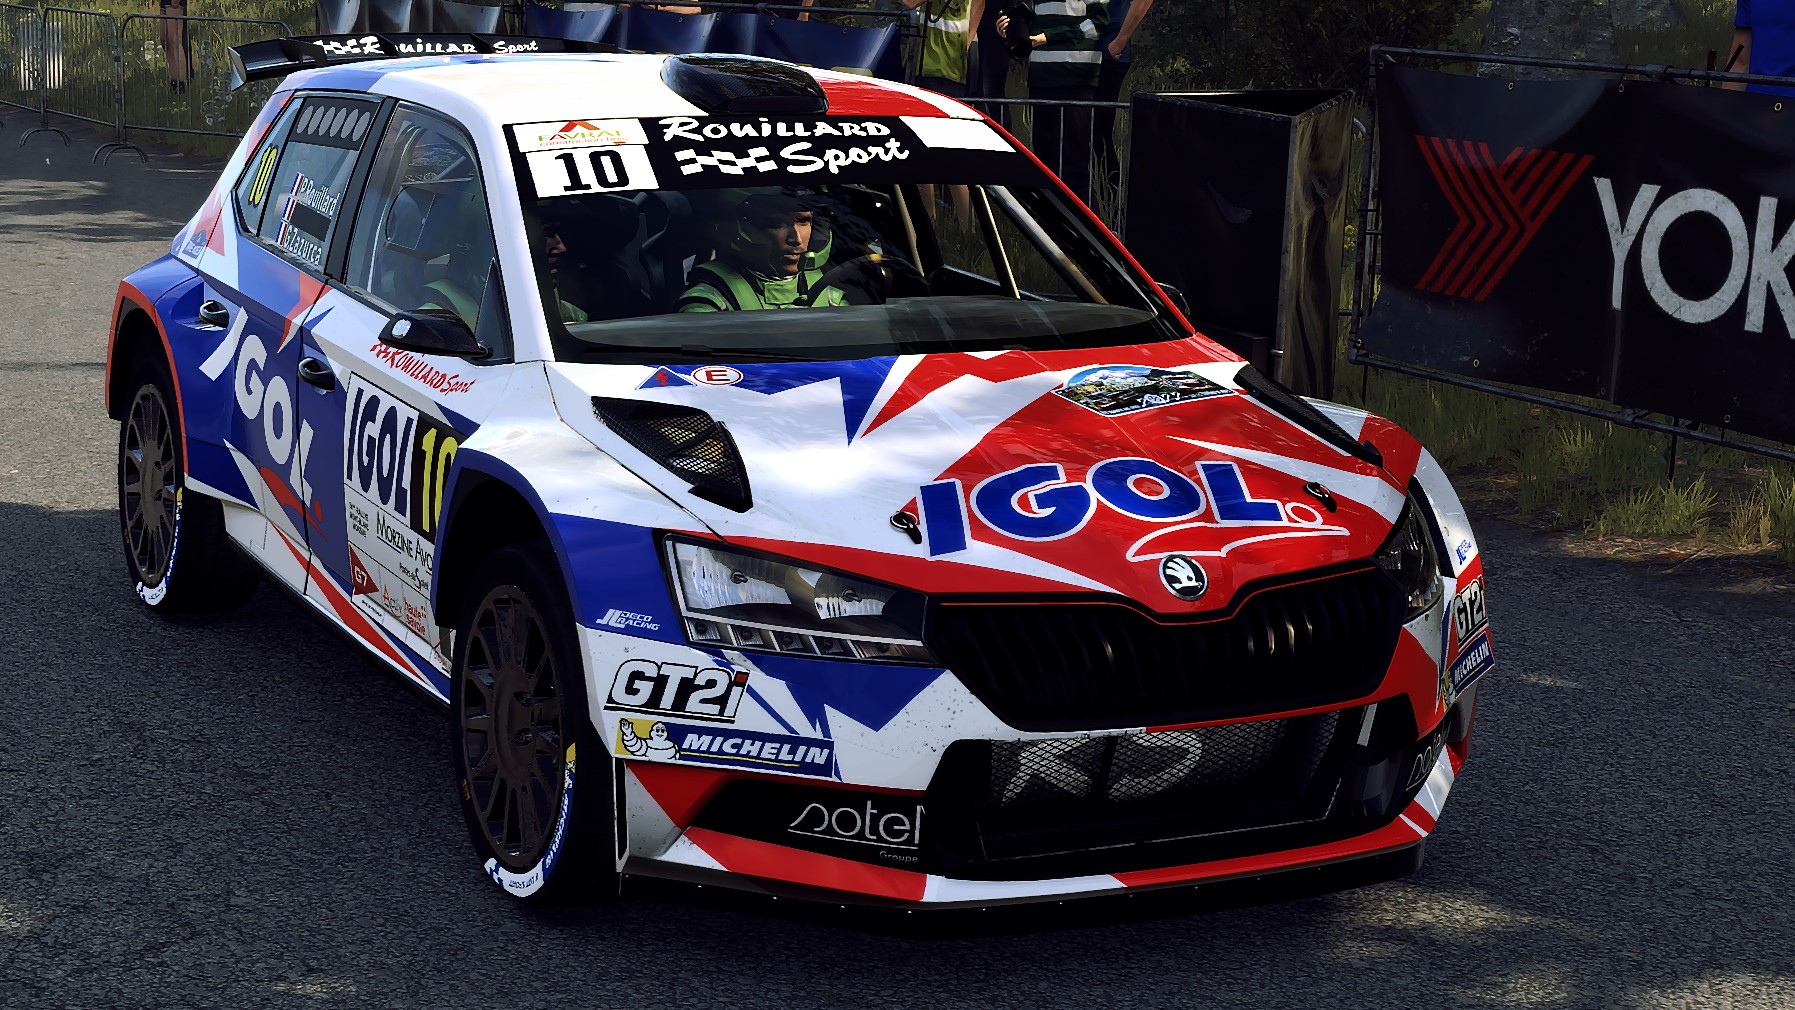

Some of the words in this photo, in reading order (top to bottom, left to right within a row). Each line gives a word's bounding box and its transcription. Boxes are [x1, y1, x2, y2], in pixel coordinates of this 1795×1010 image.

[492, 40, 539, 54] Sport
[555, 150, 629, 192] 10
[780, 137, 910, 175] Sport
[248, 143, 279, 208] 10
[705, 369, 731, 382] E
[346, 386, 415, 519] IGOL
[354, 565, 368, 588] G7
[617, 617, 660, 631] RACING
[1454, 641, 1490, 684] MICHELIN
[604, 658, 750, 722] GT2i
[682, 733, 830, 765] MICHELIN
[879, 850, 919, 863] Groupe
